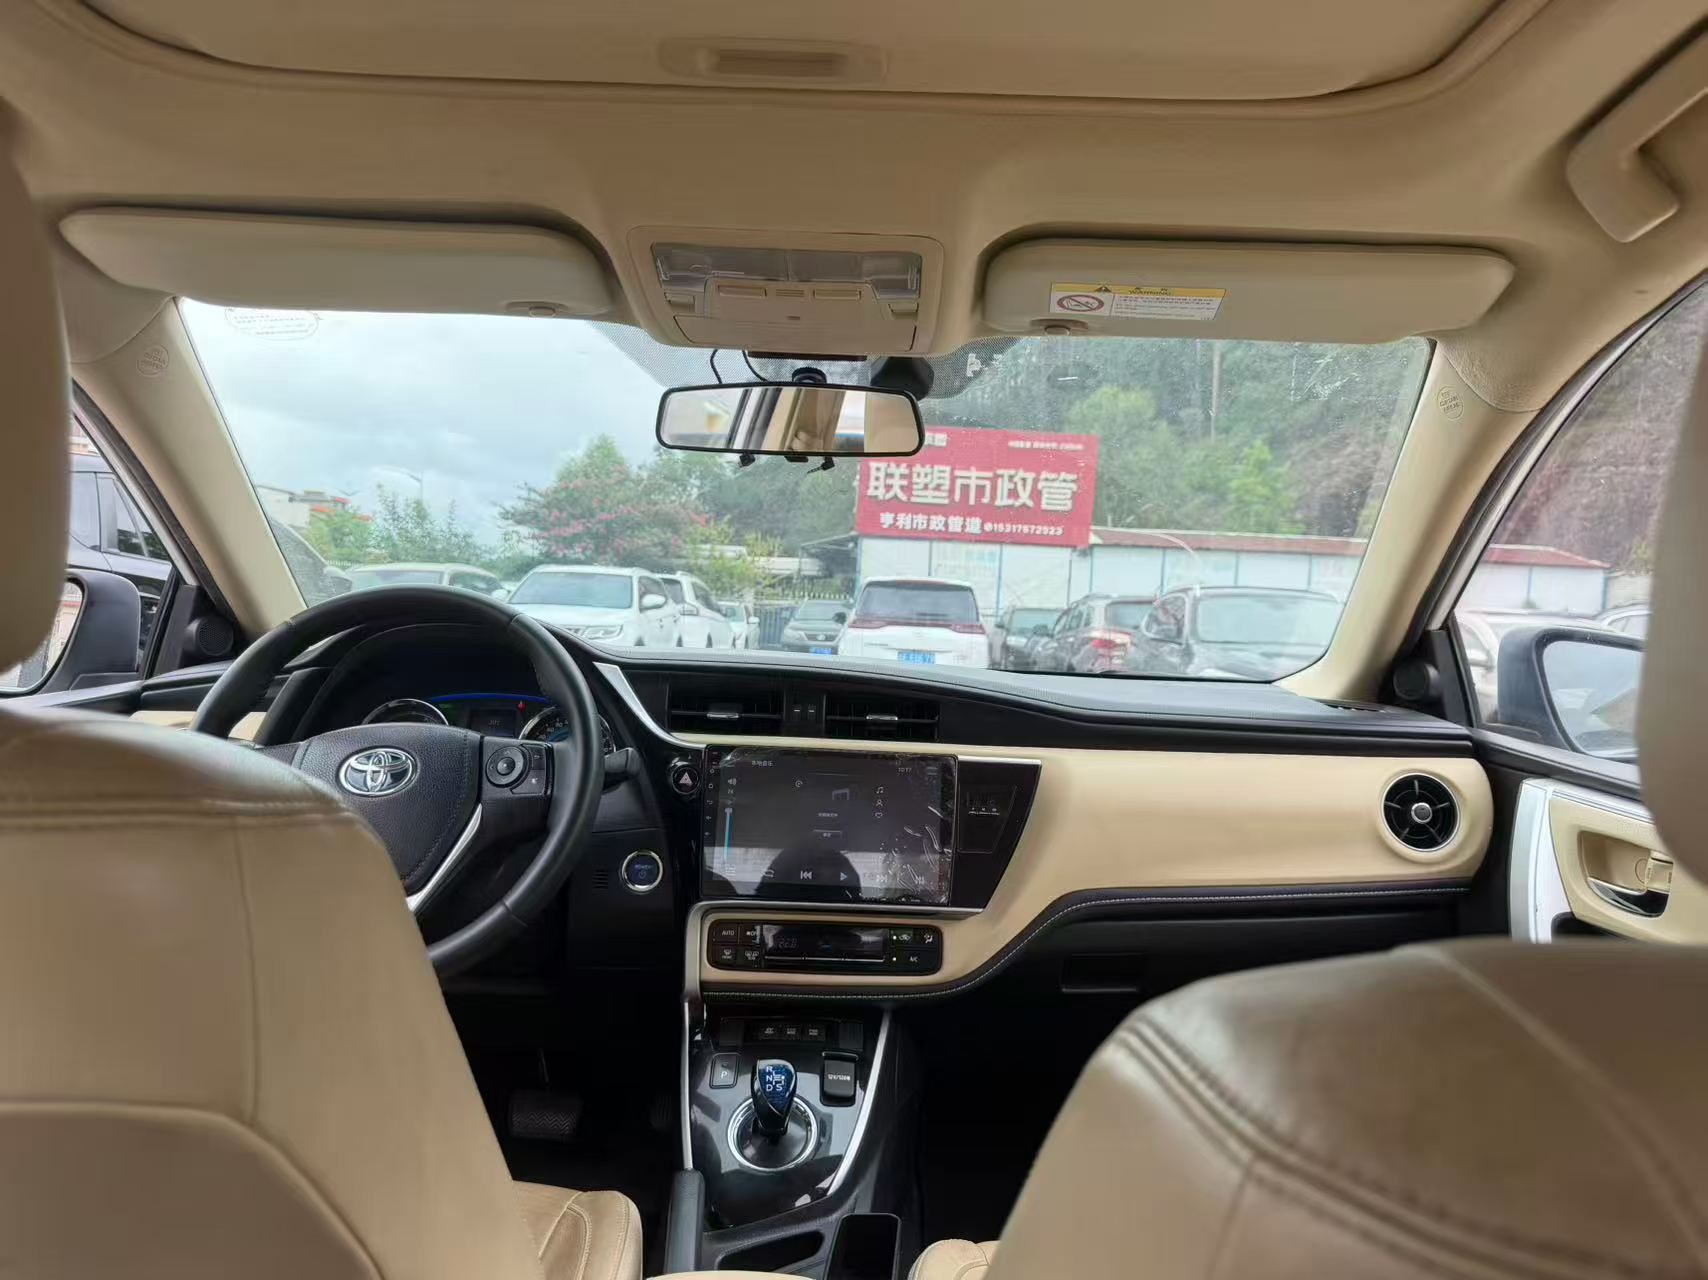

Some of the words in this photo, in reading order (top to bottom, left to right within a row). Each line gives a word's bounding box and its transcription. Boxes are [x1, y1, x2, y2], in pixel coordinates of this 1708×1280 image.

[866, 461, 1077, 511] 联塑市政管
[720, 1071, 728, 1079] P
